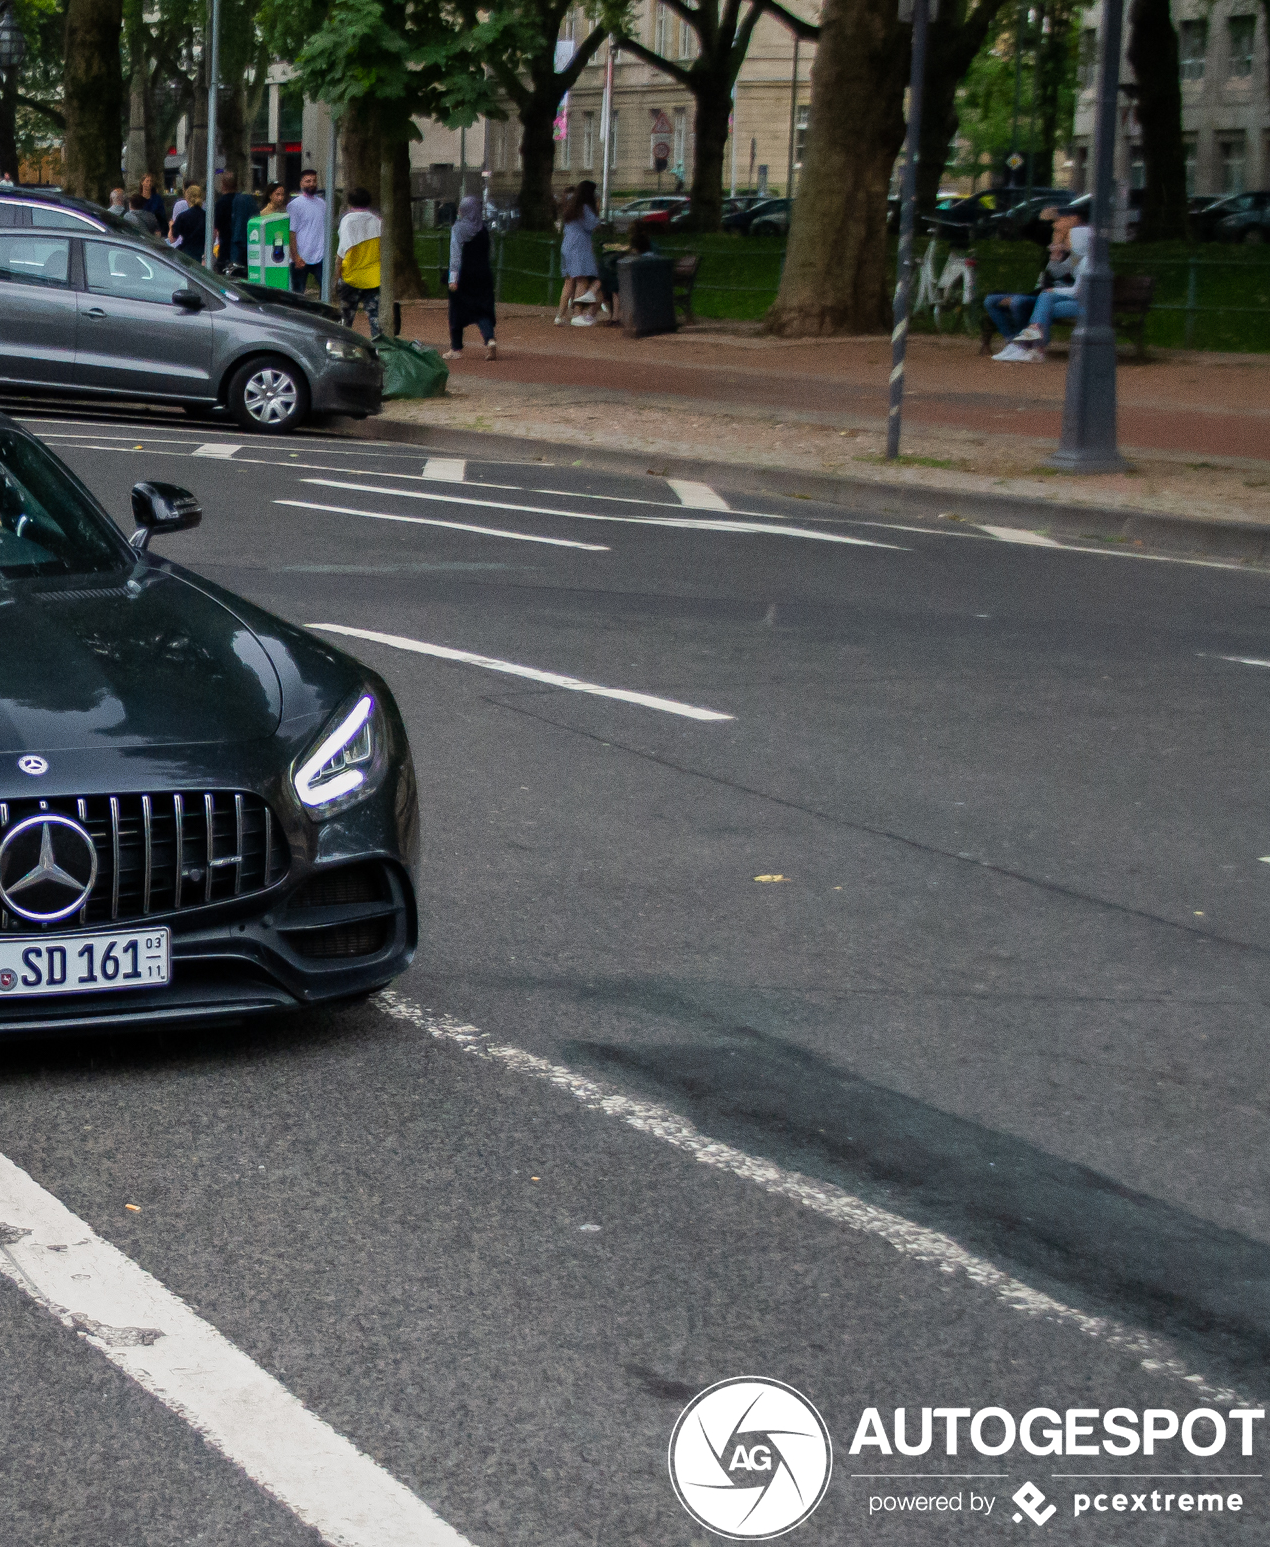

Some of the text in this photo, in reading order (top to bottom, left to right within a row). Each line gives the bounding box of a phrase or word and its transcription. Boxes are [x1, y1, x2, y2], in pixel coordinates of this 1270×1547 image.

[145, 936, 162, 949] 03
[21, 945, 67, 986] SD
[77, 938, 142, 983] 161
[146, 964, 162, 977] 11
